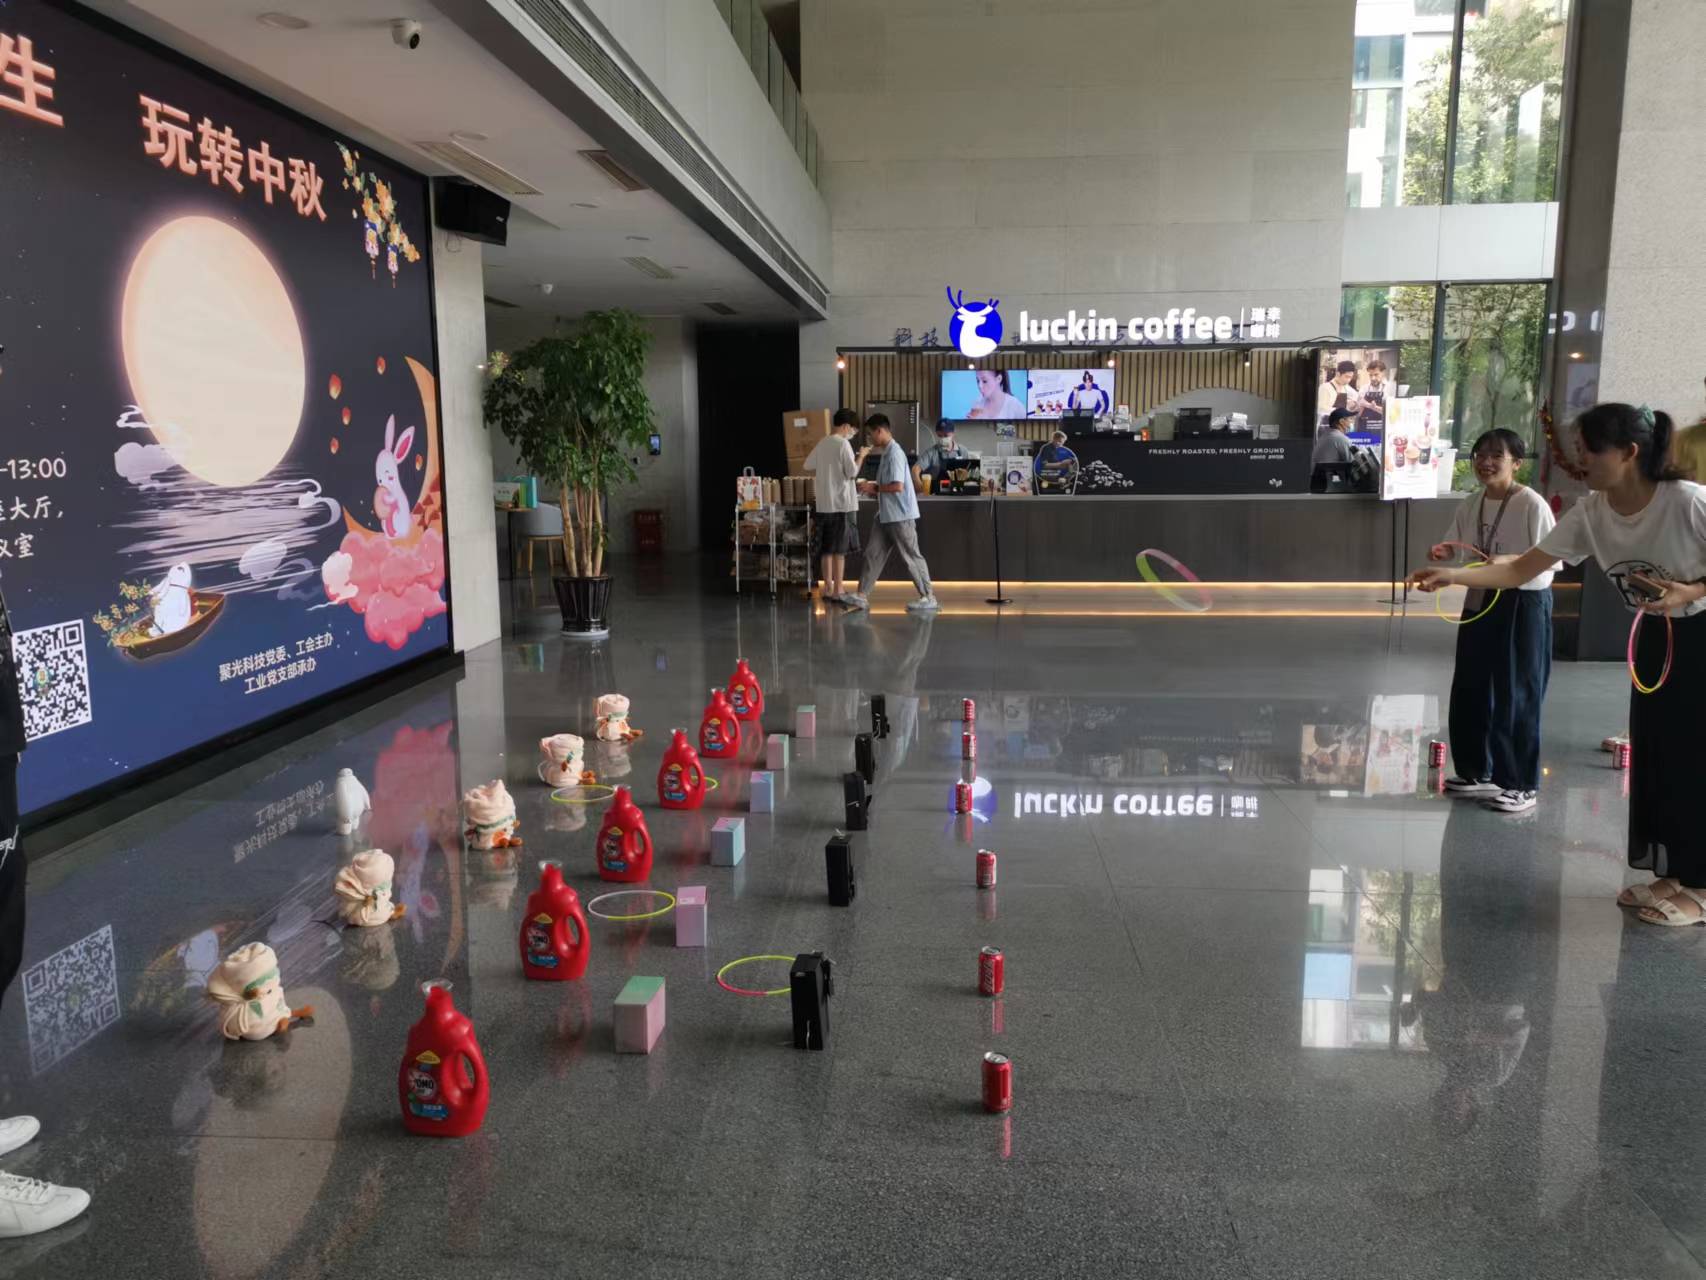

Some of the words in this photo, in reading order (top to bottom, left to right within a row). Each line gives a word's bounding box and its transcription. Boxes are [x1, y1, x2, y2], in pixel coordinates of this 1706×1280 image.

[0, 33, 63, 127] 生
[139, 93, 327, 222] 玩转中秋
[1019, 309, 1118, 342] luckin
[1127, 307, 1233, 341] coffee
[219, 631, 334, 682] 聚光科技党委、工会主办
[244, 656, 317, 695] 工业党支部承办
